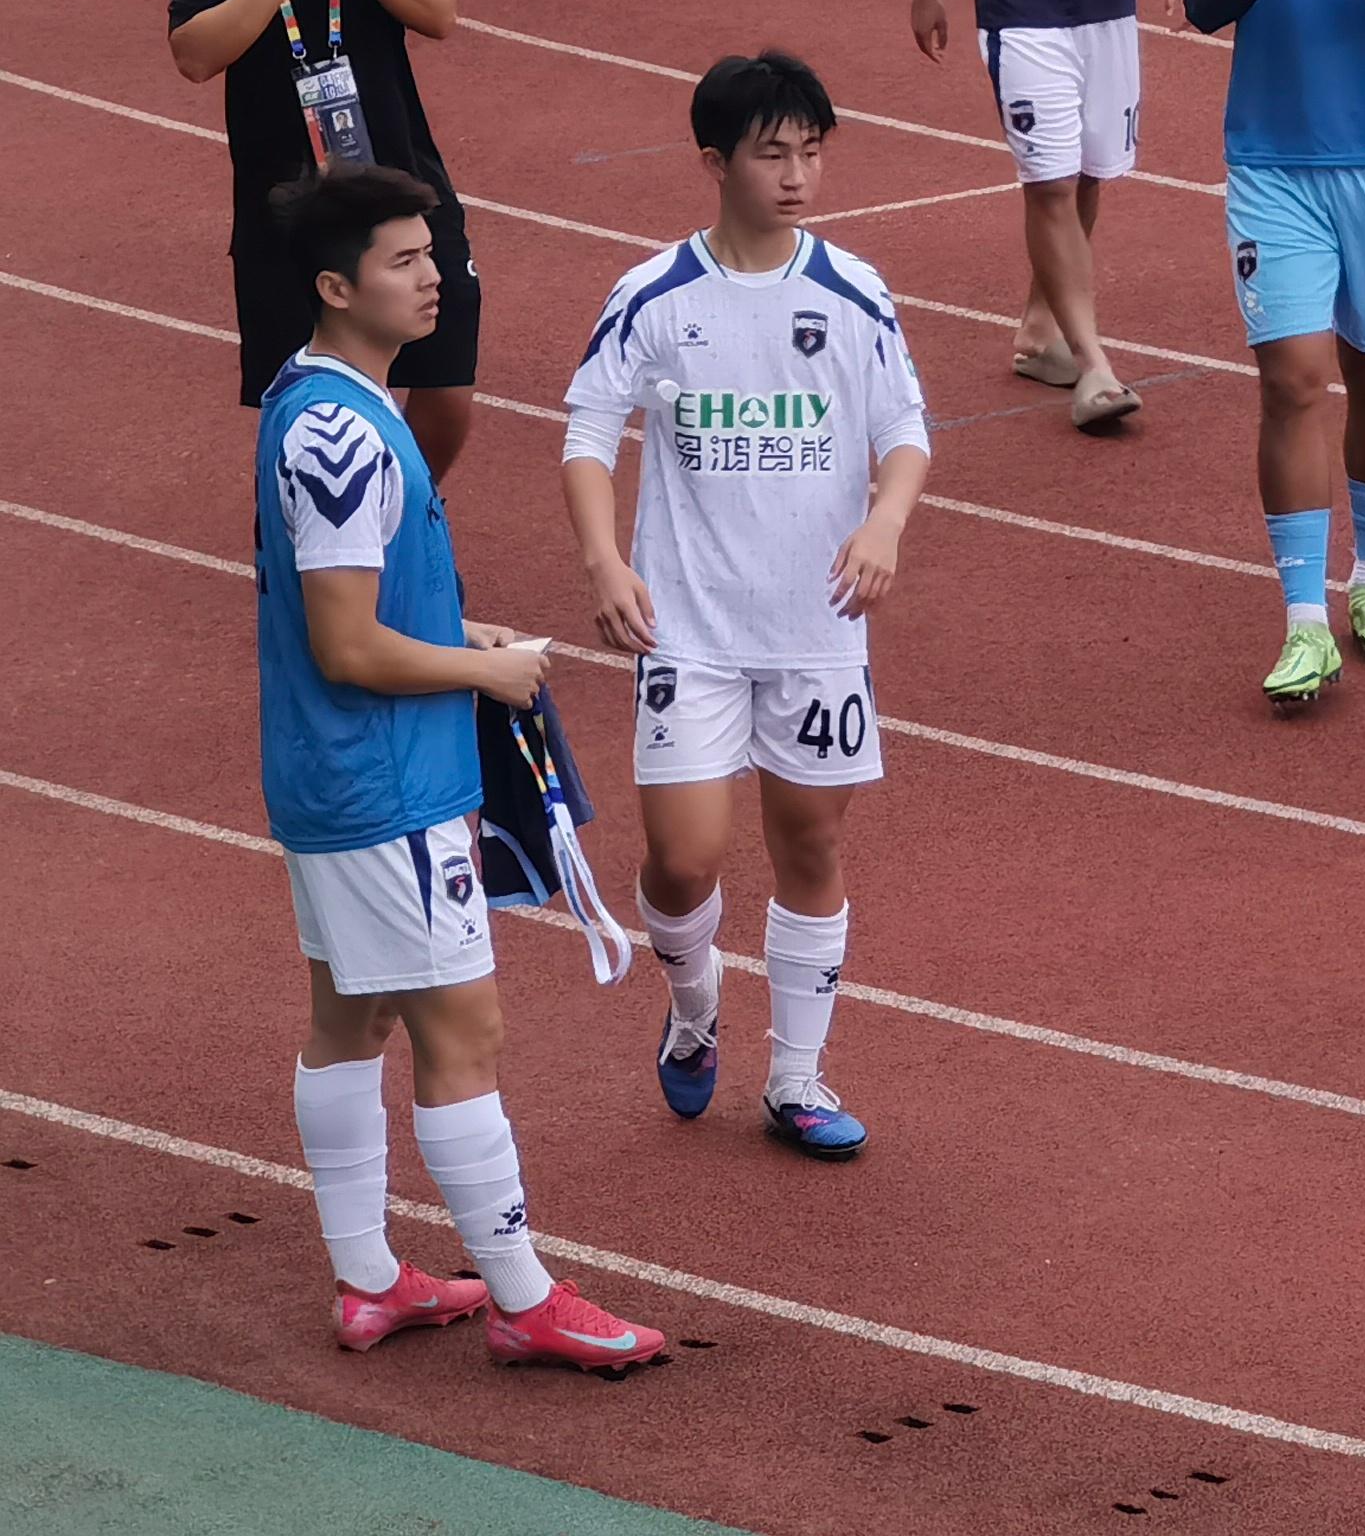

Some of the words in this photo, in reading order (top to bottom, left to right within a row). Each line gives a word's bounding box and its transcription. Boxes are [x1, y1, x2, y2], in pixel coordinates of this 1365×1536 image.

[675, 433, 832, 472] 易鸿智能
[797, 693, 867, 759] 40
